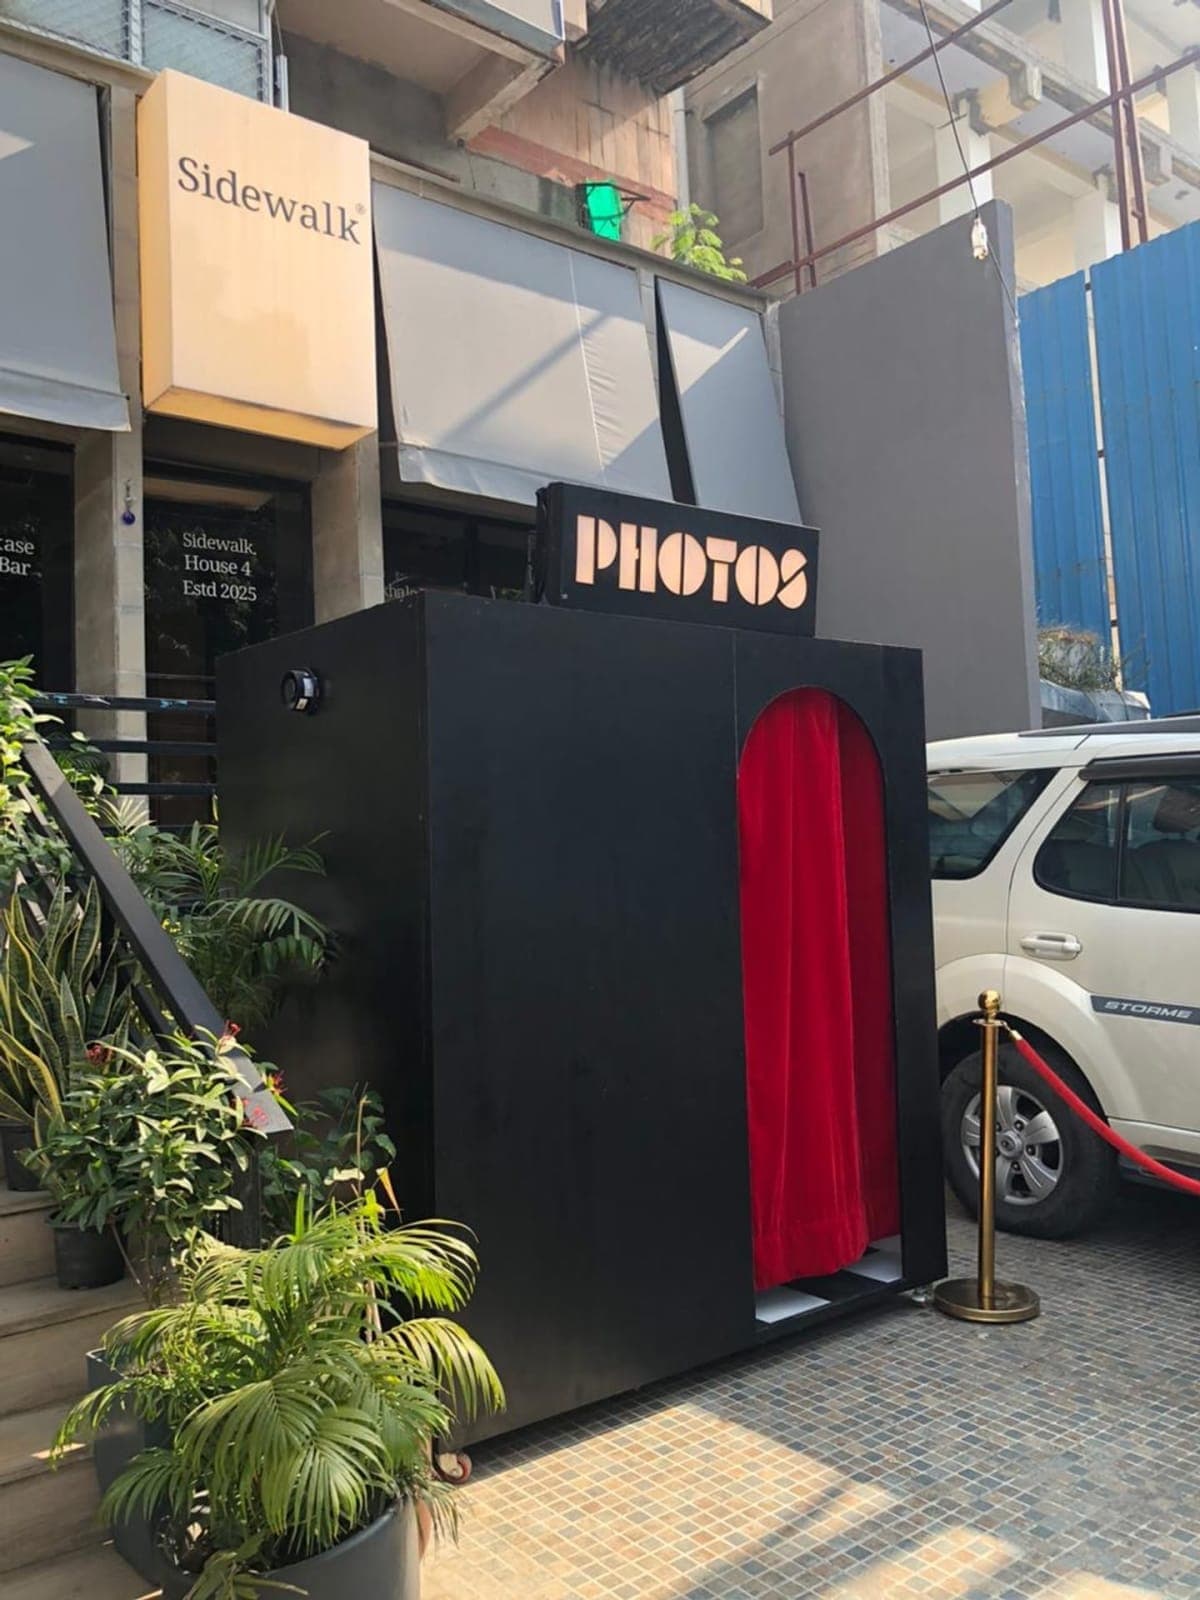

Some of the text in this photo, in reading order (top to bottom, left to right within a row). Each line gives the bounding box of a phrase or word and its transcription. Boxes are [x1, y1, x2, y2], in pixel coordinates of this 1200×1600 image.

[183, 532, 257, 556] Sidewalk
[0, 556, 32, 576] Bar
[184, 554, 252, 577] House 4
[575, 514, 808, 610] PHOTOS
[183, 579, 257, 602] Estd 2025
[1104, 1000, 1192, 1019] STORME
